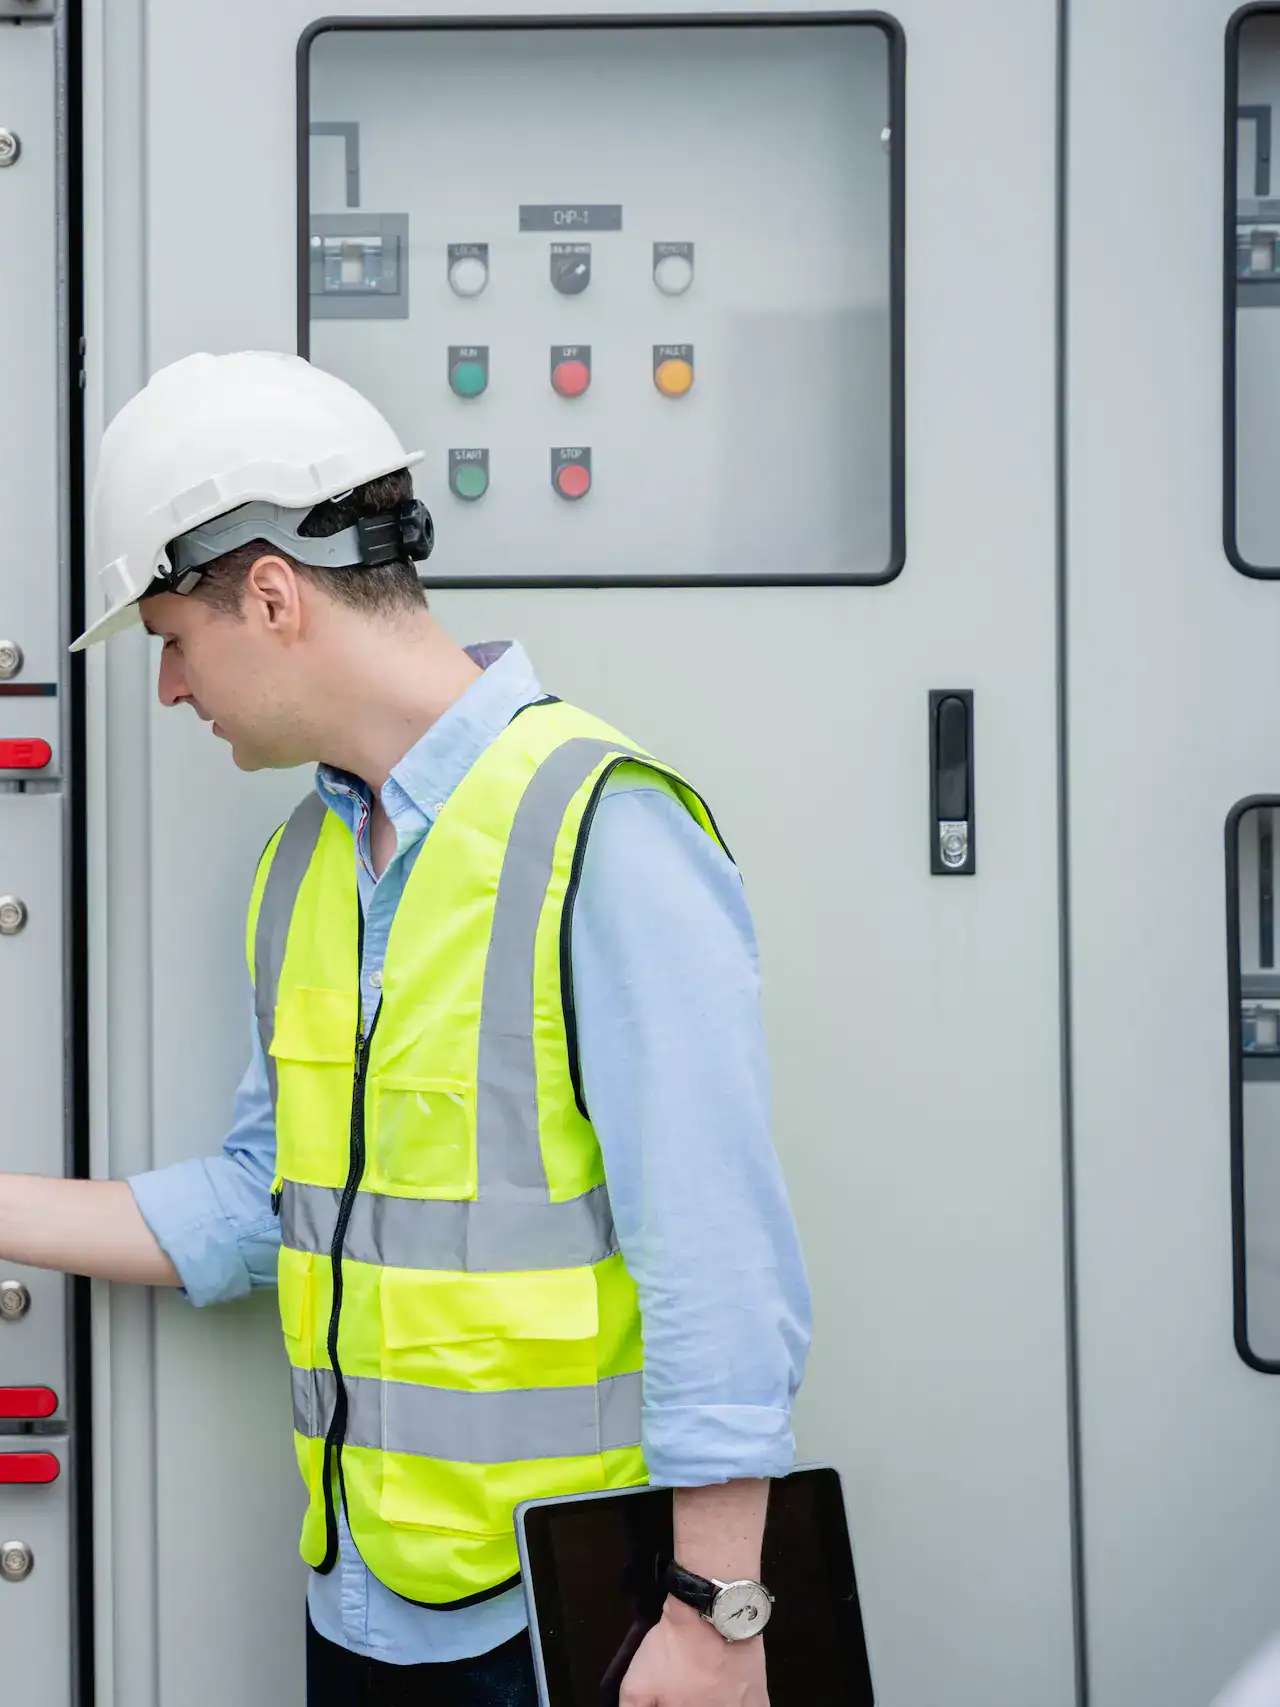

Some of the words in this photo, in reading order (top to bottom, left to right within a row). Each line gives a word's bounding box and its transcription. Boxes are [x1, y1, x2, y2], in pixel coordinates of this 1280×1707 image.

[553, 210, 589, 225] CHP-1
[459, 348, 478, 357] RUN
[563, 347, 579, 356] OFF
[659, 346, 687, 356] FAULT
[455, 451, 482, 460] START
[560, 450, 583, 459] STOP
